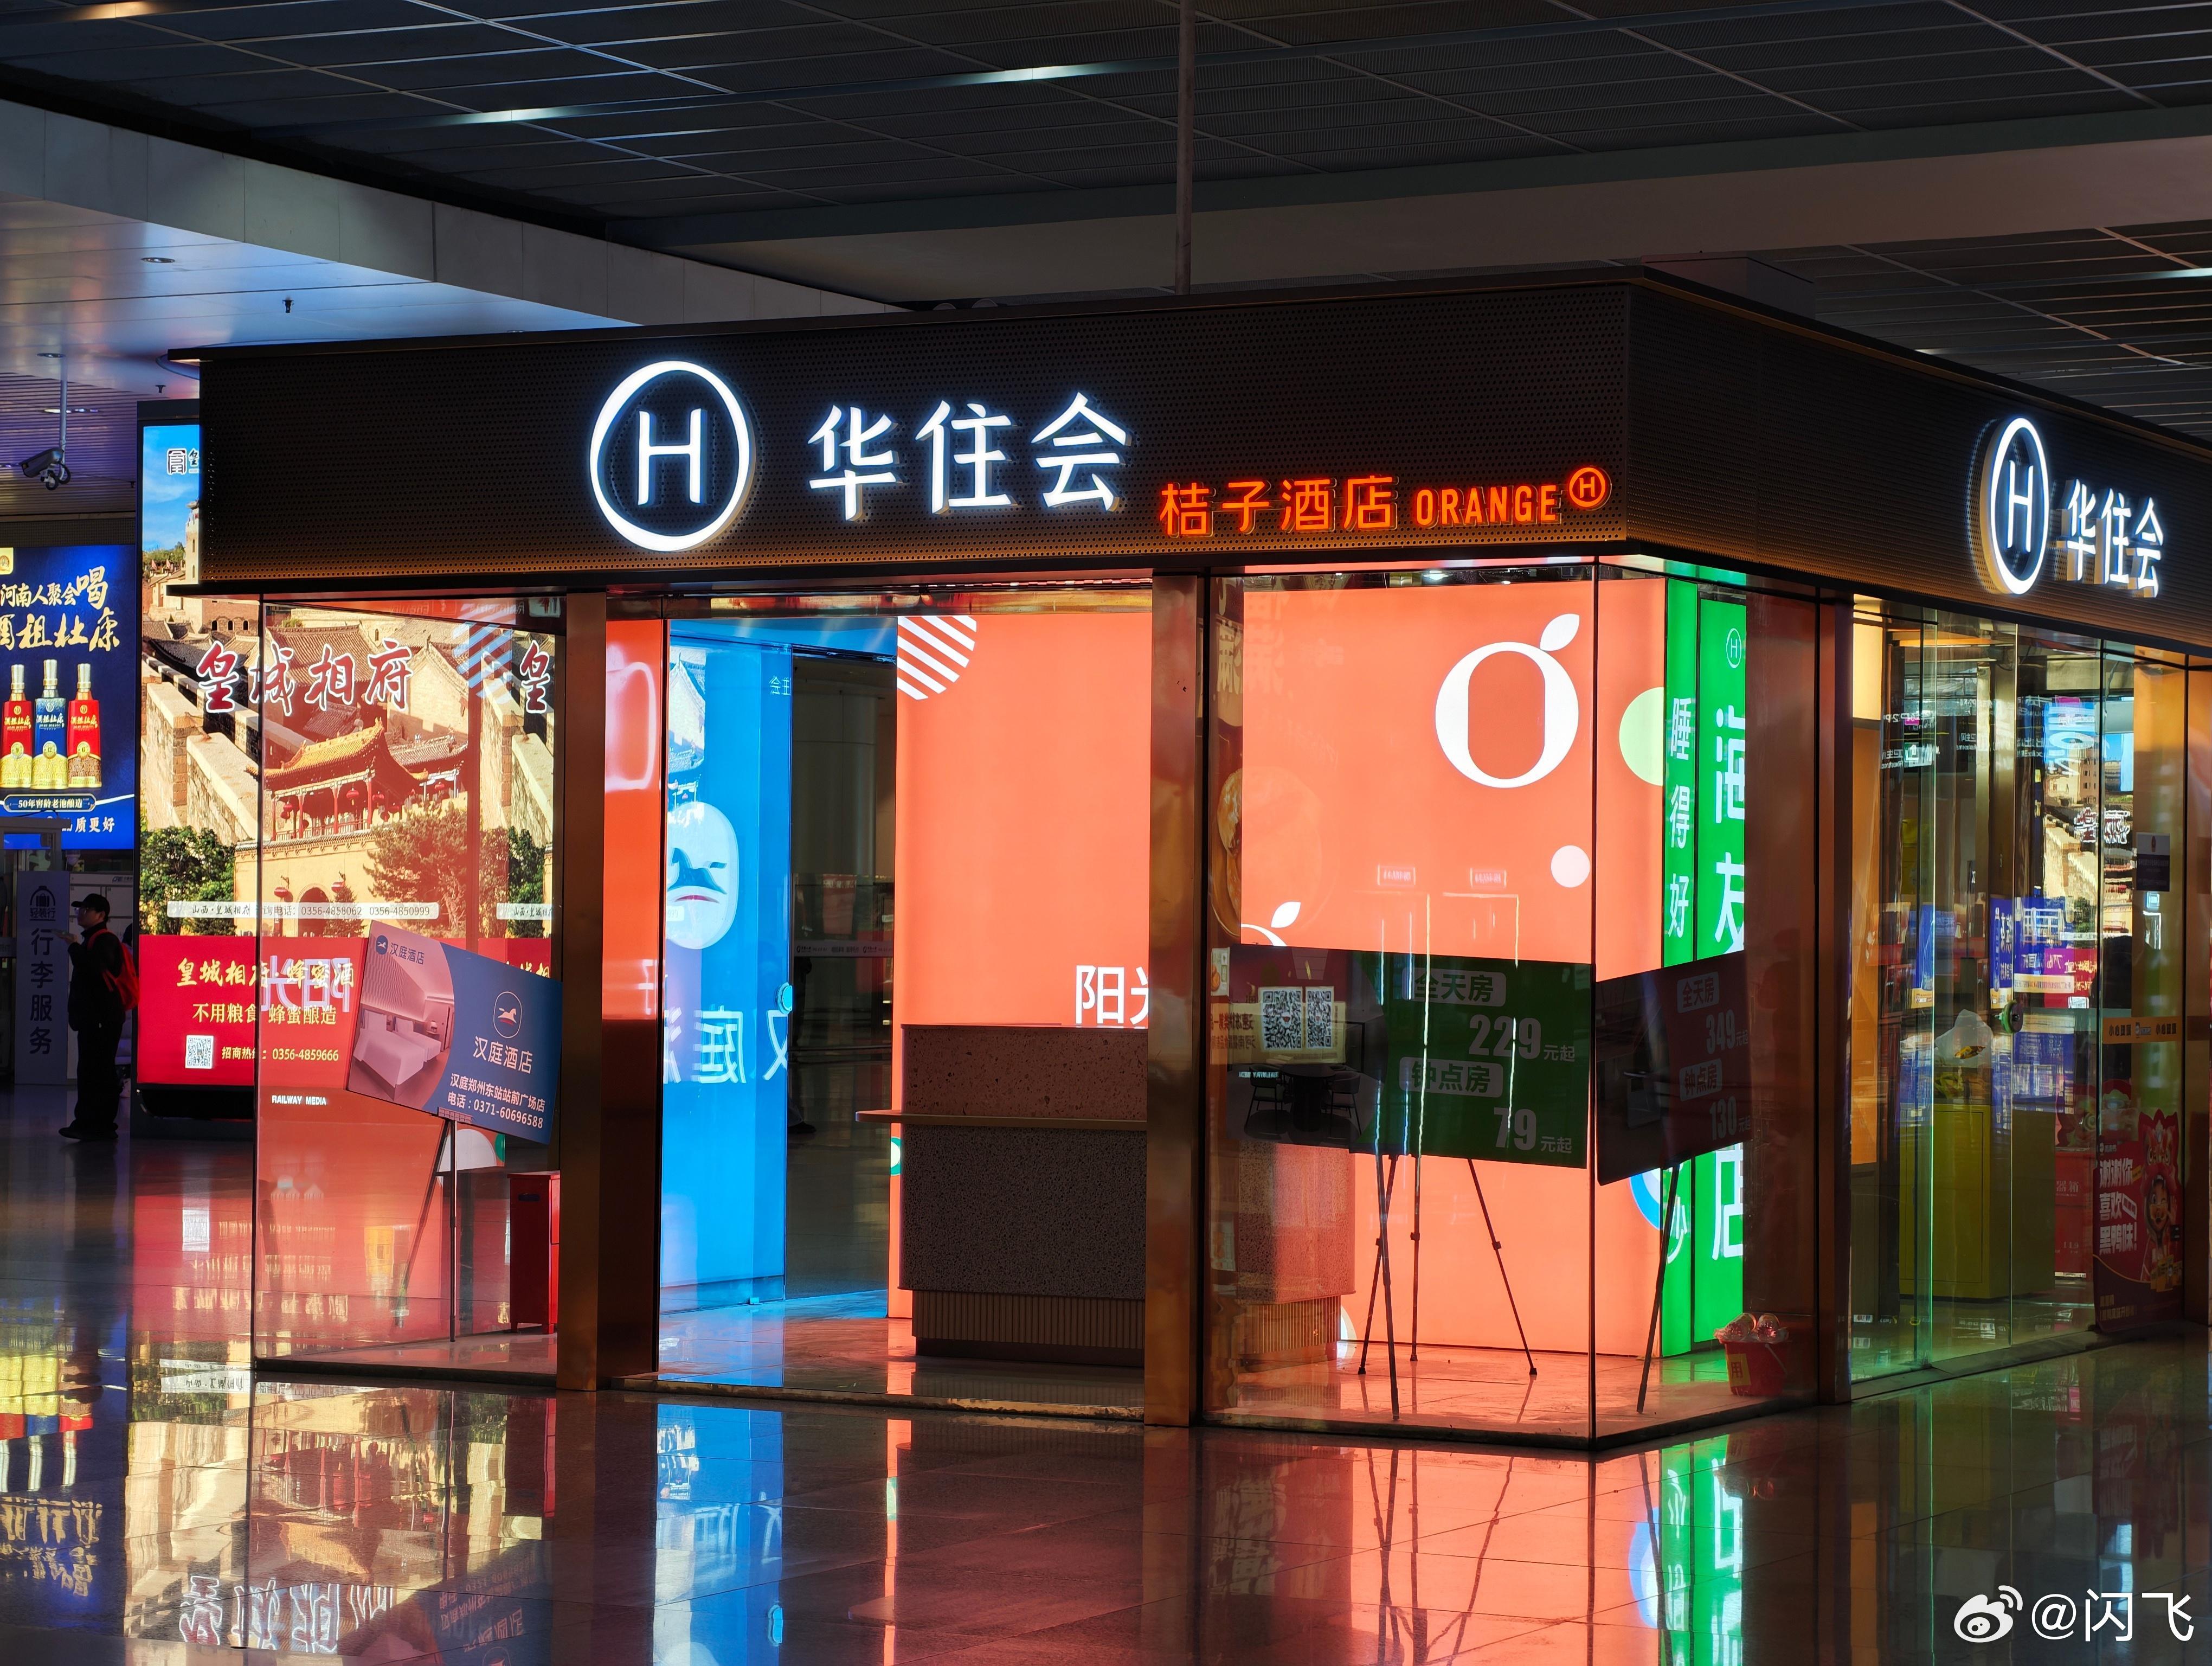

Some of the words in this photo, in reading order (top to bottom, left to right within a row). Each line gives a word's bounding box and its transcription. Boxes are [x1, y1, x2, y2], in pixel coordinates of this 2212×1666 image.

[807, 392, 1133, 522] 华住会
[1160, 475, 1394, 536] 桔子酒店
[1416, 485, 1558, 526] ORANGE
[2066, 478, 2164, 598] 华住会
[1, 566, 108, 610] 河南人聚会喝
[197, 639, 414, 716] 皇城相府
[1668, 697, 1692, 938] 睡得好
[369, 906, 430, 917] 0356-4850999
[389, 942, 426, 965] 汉庭酒店
[29, 927, 54, 1055] 行李服务
[1414, 973, 1494, 1002] 全天房
[1682, 977, 1714, 1009] 全天房
[192, 1003, 257, 1024] 不用粮食
[268, 1004, 337, 1025] 蜂蜜酿造
[472, 1035, 534, 1075] 汉庭酒店
[449, 1073, 546, 1113] 汉庭郑州东站站前广场店
[1411, 1061, 1491, 1093] 钟点房
[1684, 1063, 1718, 1095] 钟点房
[272, 1095, 303, 1105] RAILWAY
[305, 1096, 326, 1106] MEDIA
[2099, 1157, 2133, 1189] 谢谢你
[2099, 1191, 2122, 1221] 喜欢
